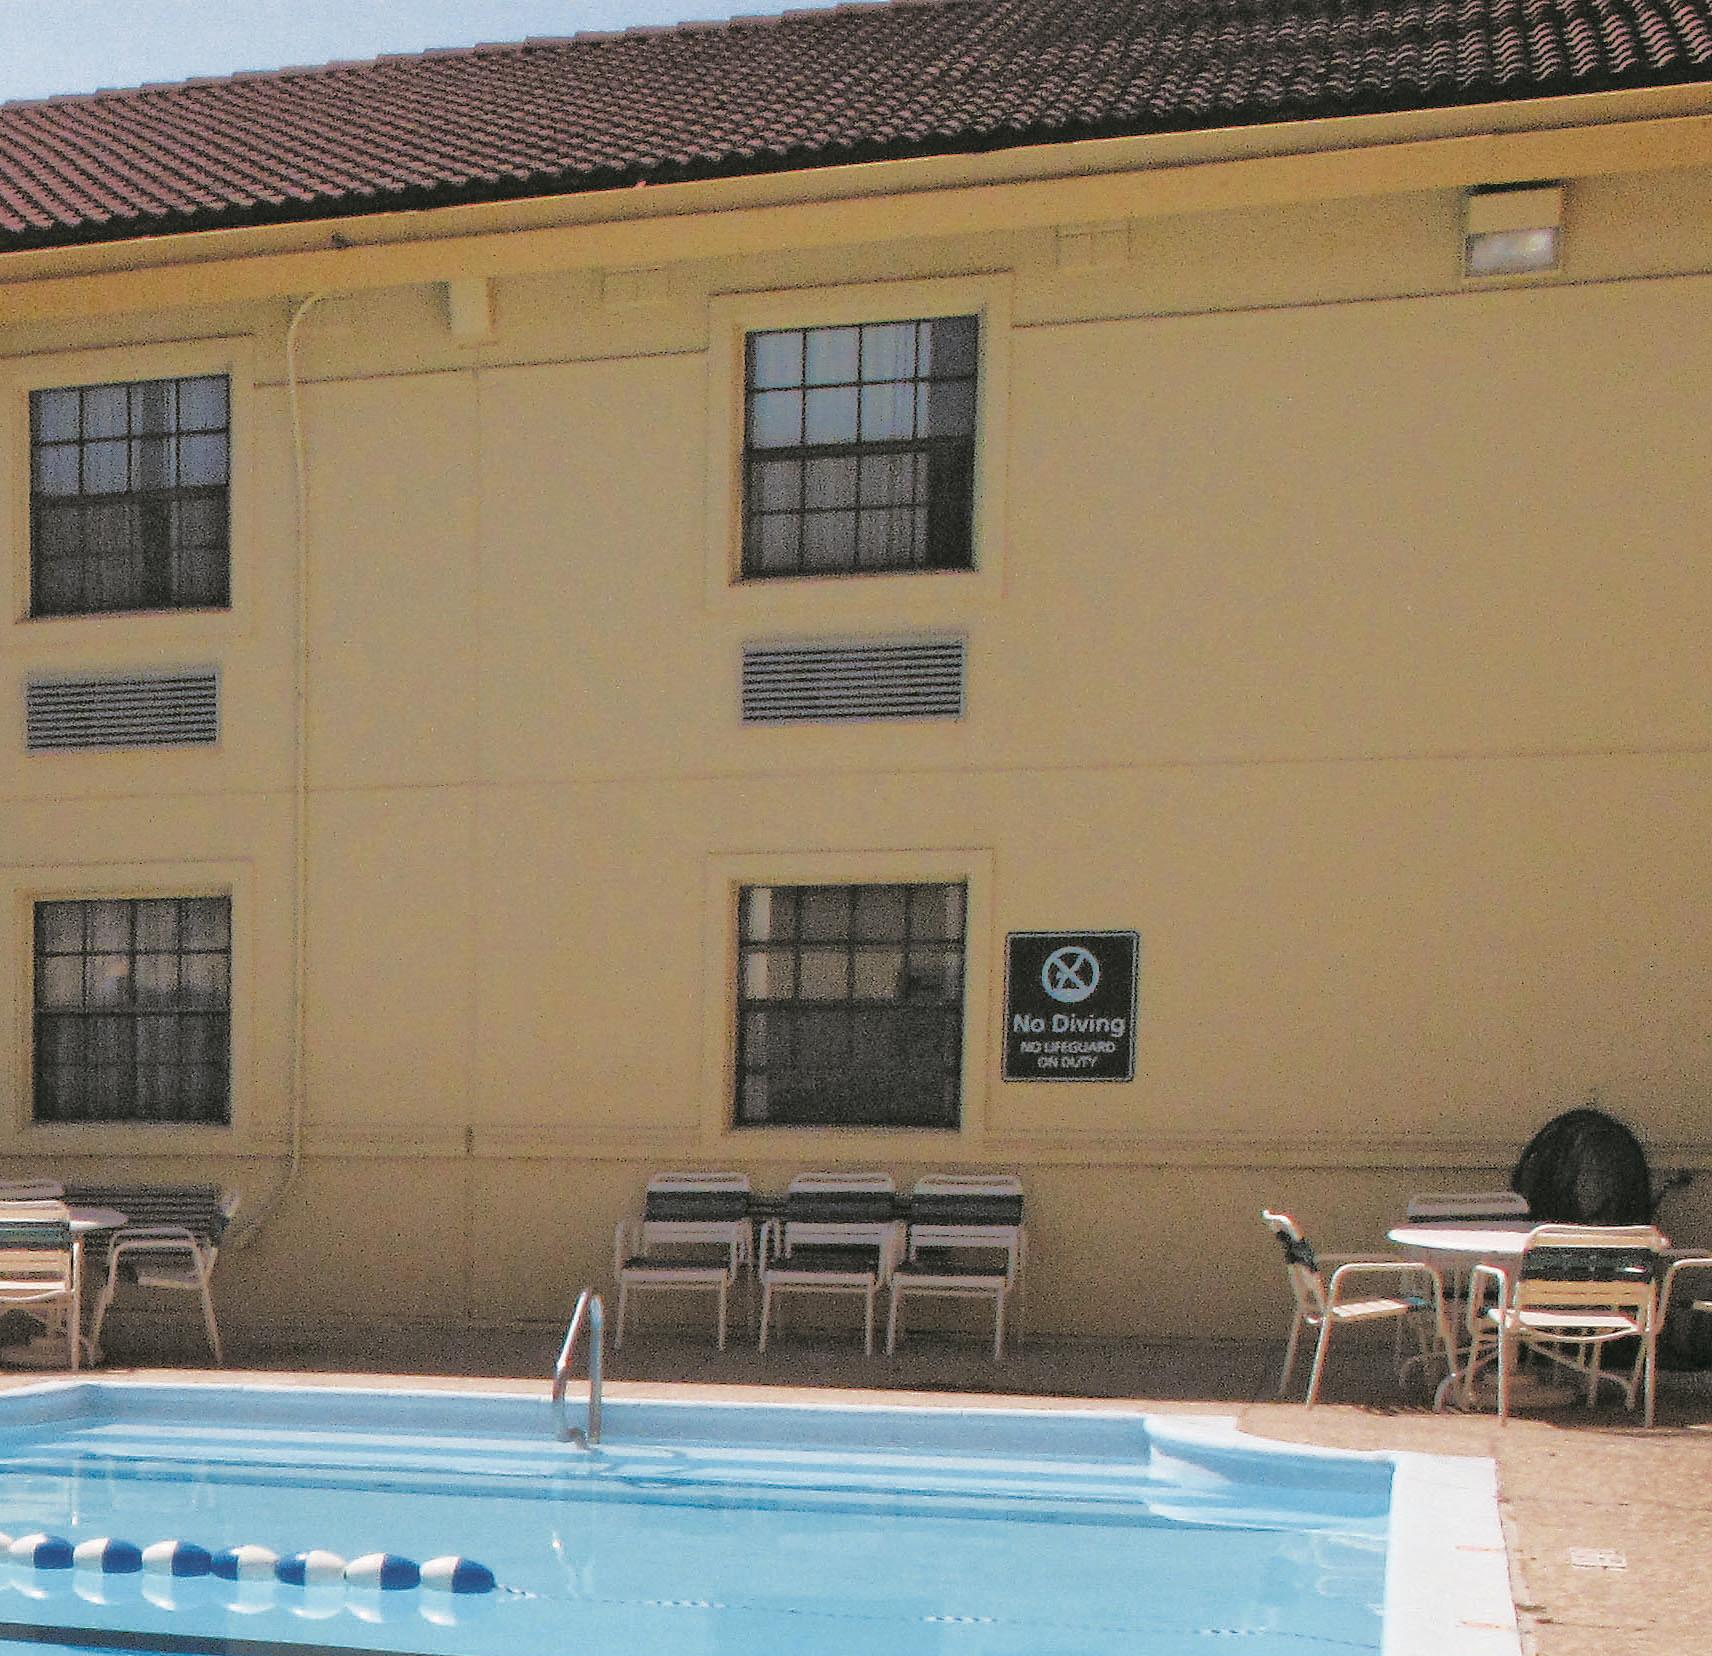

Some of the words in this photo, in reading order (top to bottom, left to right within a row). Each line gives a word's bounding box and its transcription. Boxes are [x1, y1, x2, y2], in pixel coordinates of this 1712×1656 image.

[1013, 1014, 1045, 1033] No
[1052, 1013, 1126, 1038] Diving
[1020, 1041, 1042, 1053] NO
[1044, 1041, 1116, 1053] LIFEGUARD
[1037, 1056, 1059, 1068] ON
[1061, 1056, 1098, 1068] DUTY
